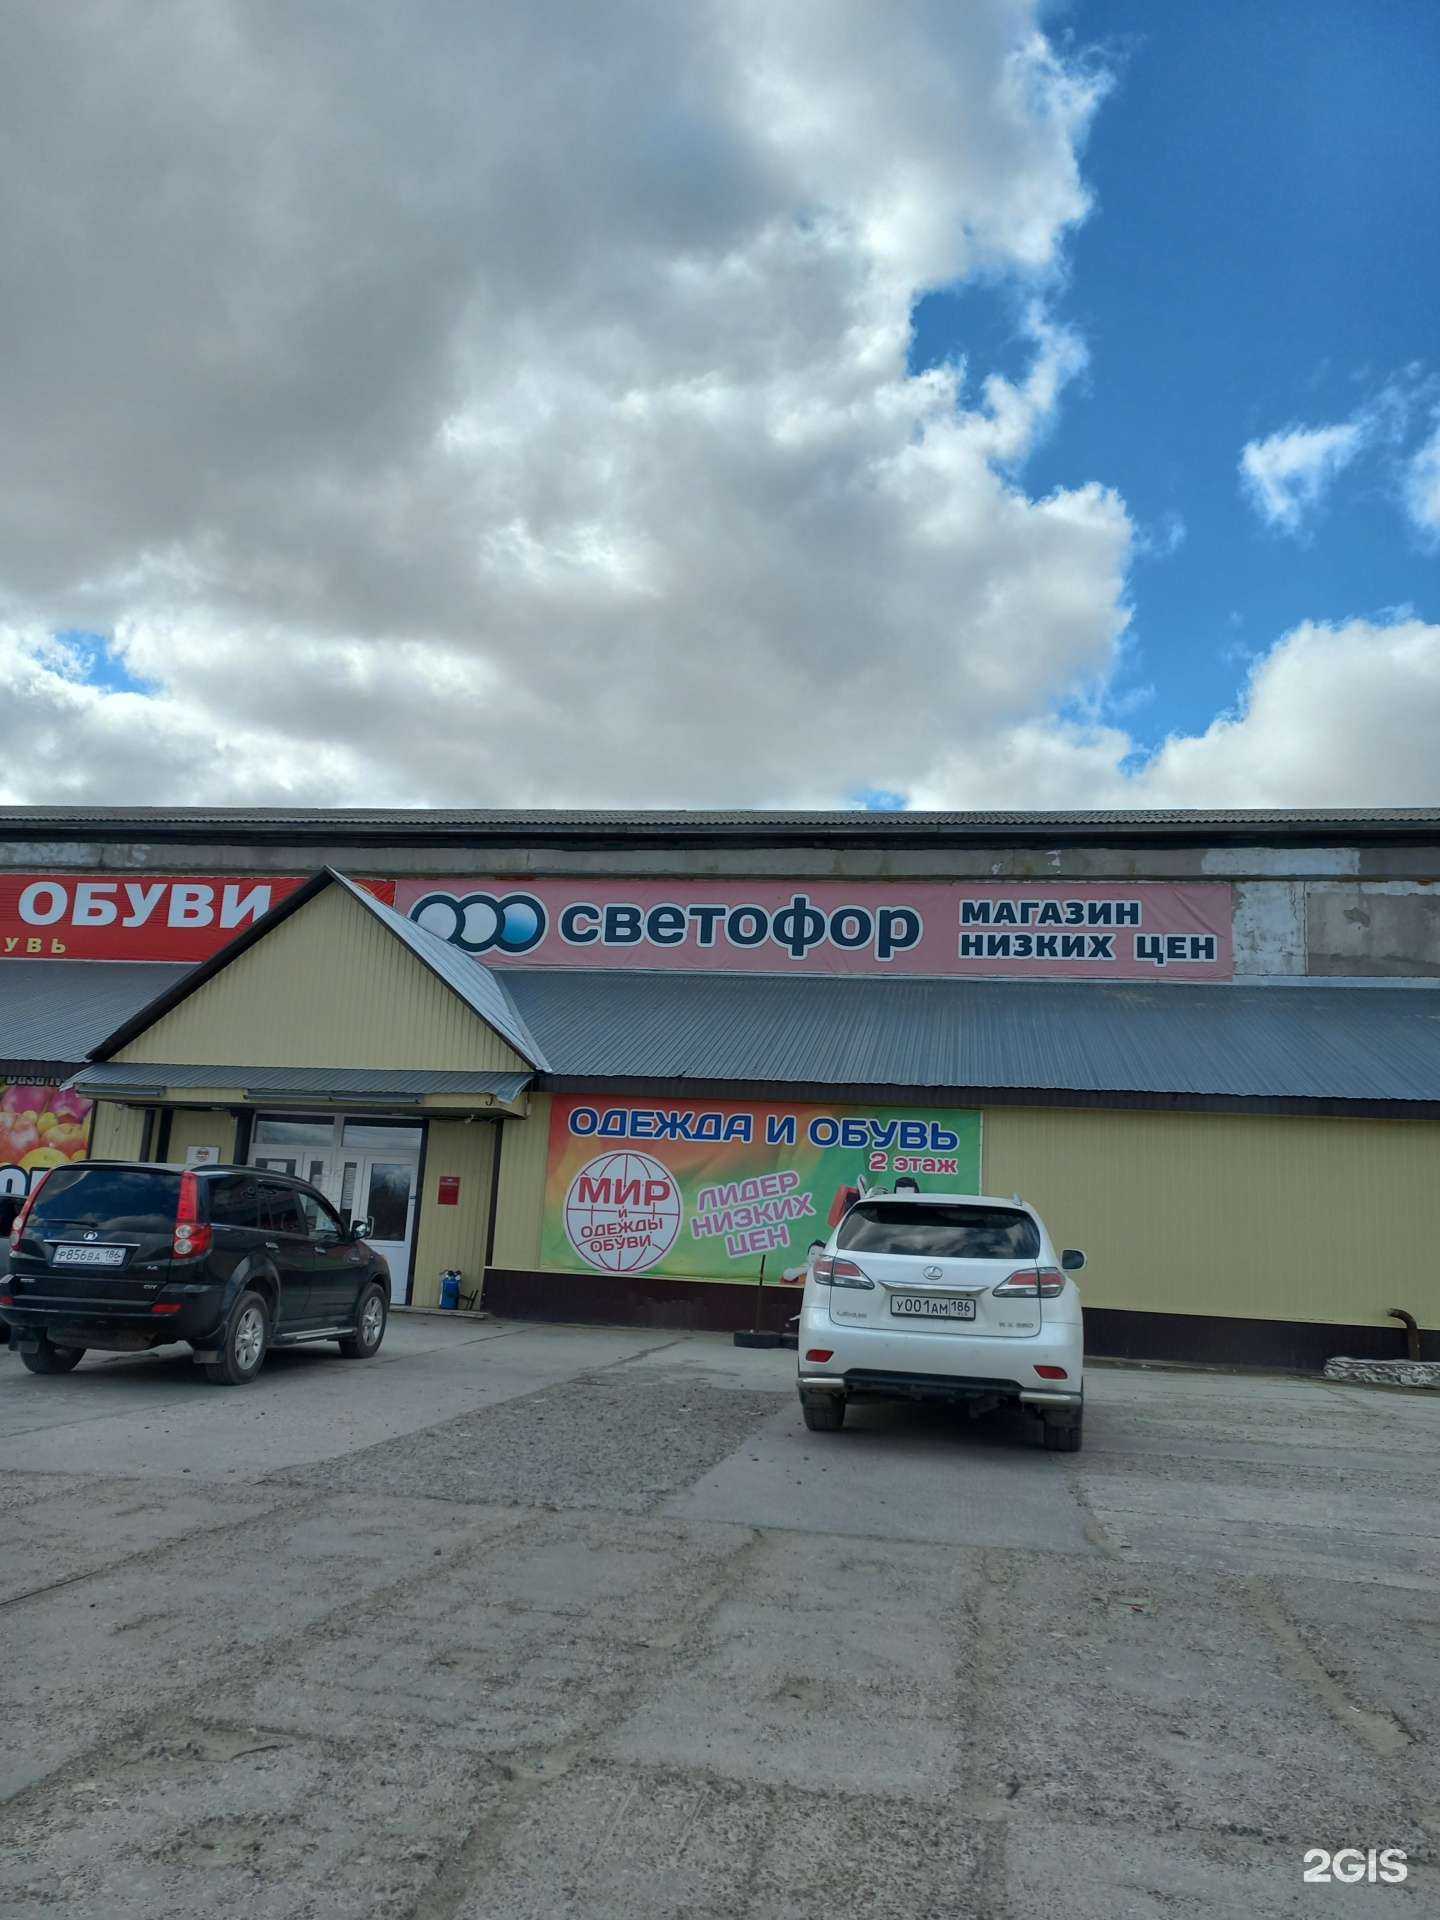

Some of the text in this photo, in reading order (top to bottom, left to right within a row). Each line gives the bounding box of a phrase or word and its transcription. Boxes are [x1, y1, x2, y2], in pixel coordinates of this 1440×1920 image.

[18, 880, 273, 929] ОБУВИ
[961, 901, 1140, 926] МАГАЗИН
[960, 933, 1215, 964] НИЗКИХ ЦЕН
[569, 1108, 960, 1152] ОДЕЖДА И ОБУВЬ
[870, 1153, 958, 1174] 2 этаж
[578, 1176, 672, 1207] МИР
[698, 1172, 799, 1211] ЛИДЕР
[580, 1217, 664, 1239] ОДЕЖДЫ
[691, 1194, 815, 1237] НИЗКИХ
[590, 1234, 652, 1253] ОБУВИ
[727, 1225, 790, 1257] ЦЕН
